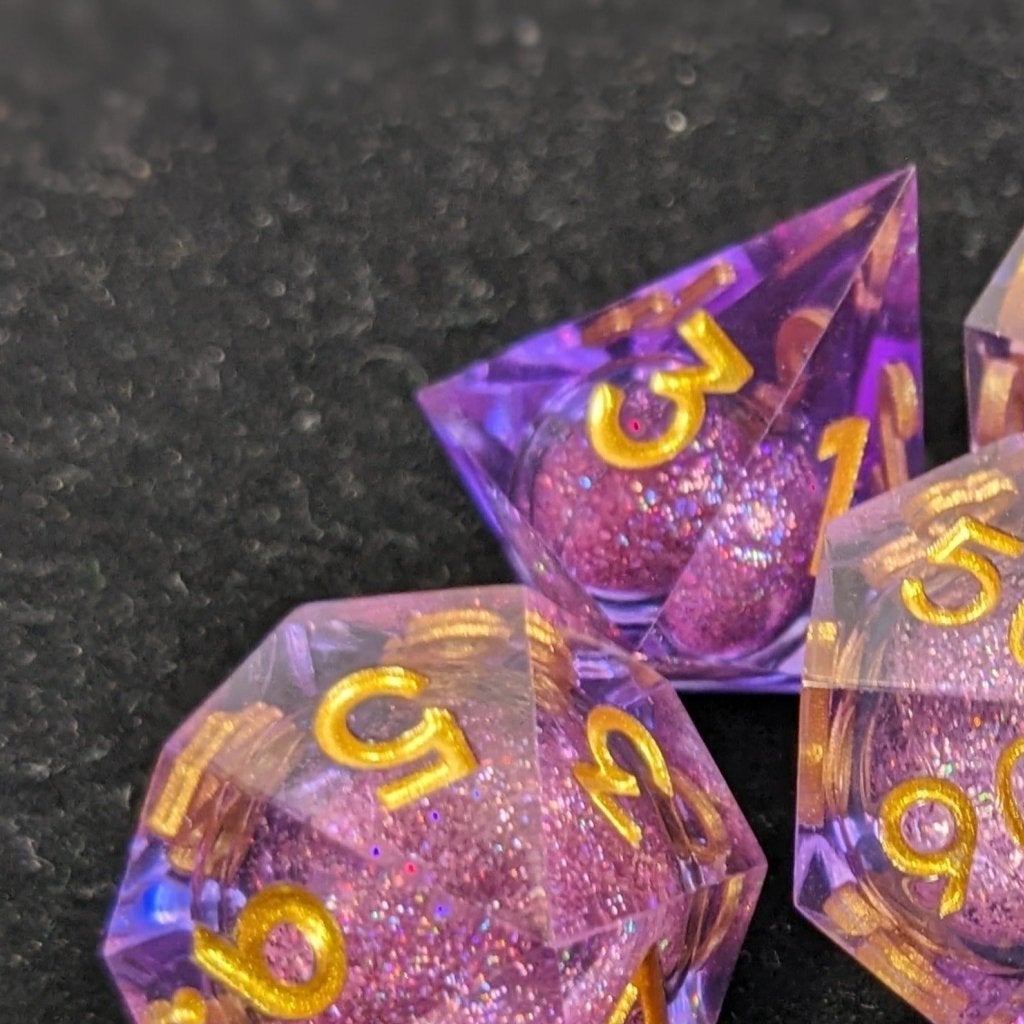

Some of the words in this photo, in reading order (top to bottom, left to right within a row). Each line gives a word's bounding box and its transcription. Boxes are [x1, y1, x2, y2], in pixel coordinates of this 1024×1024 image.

[587, 310, 755, 470] 3
[809, 416, 872, 577] 1
[313, 665, 481, 812] 5
